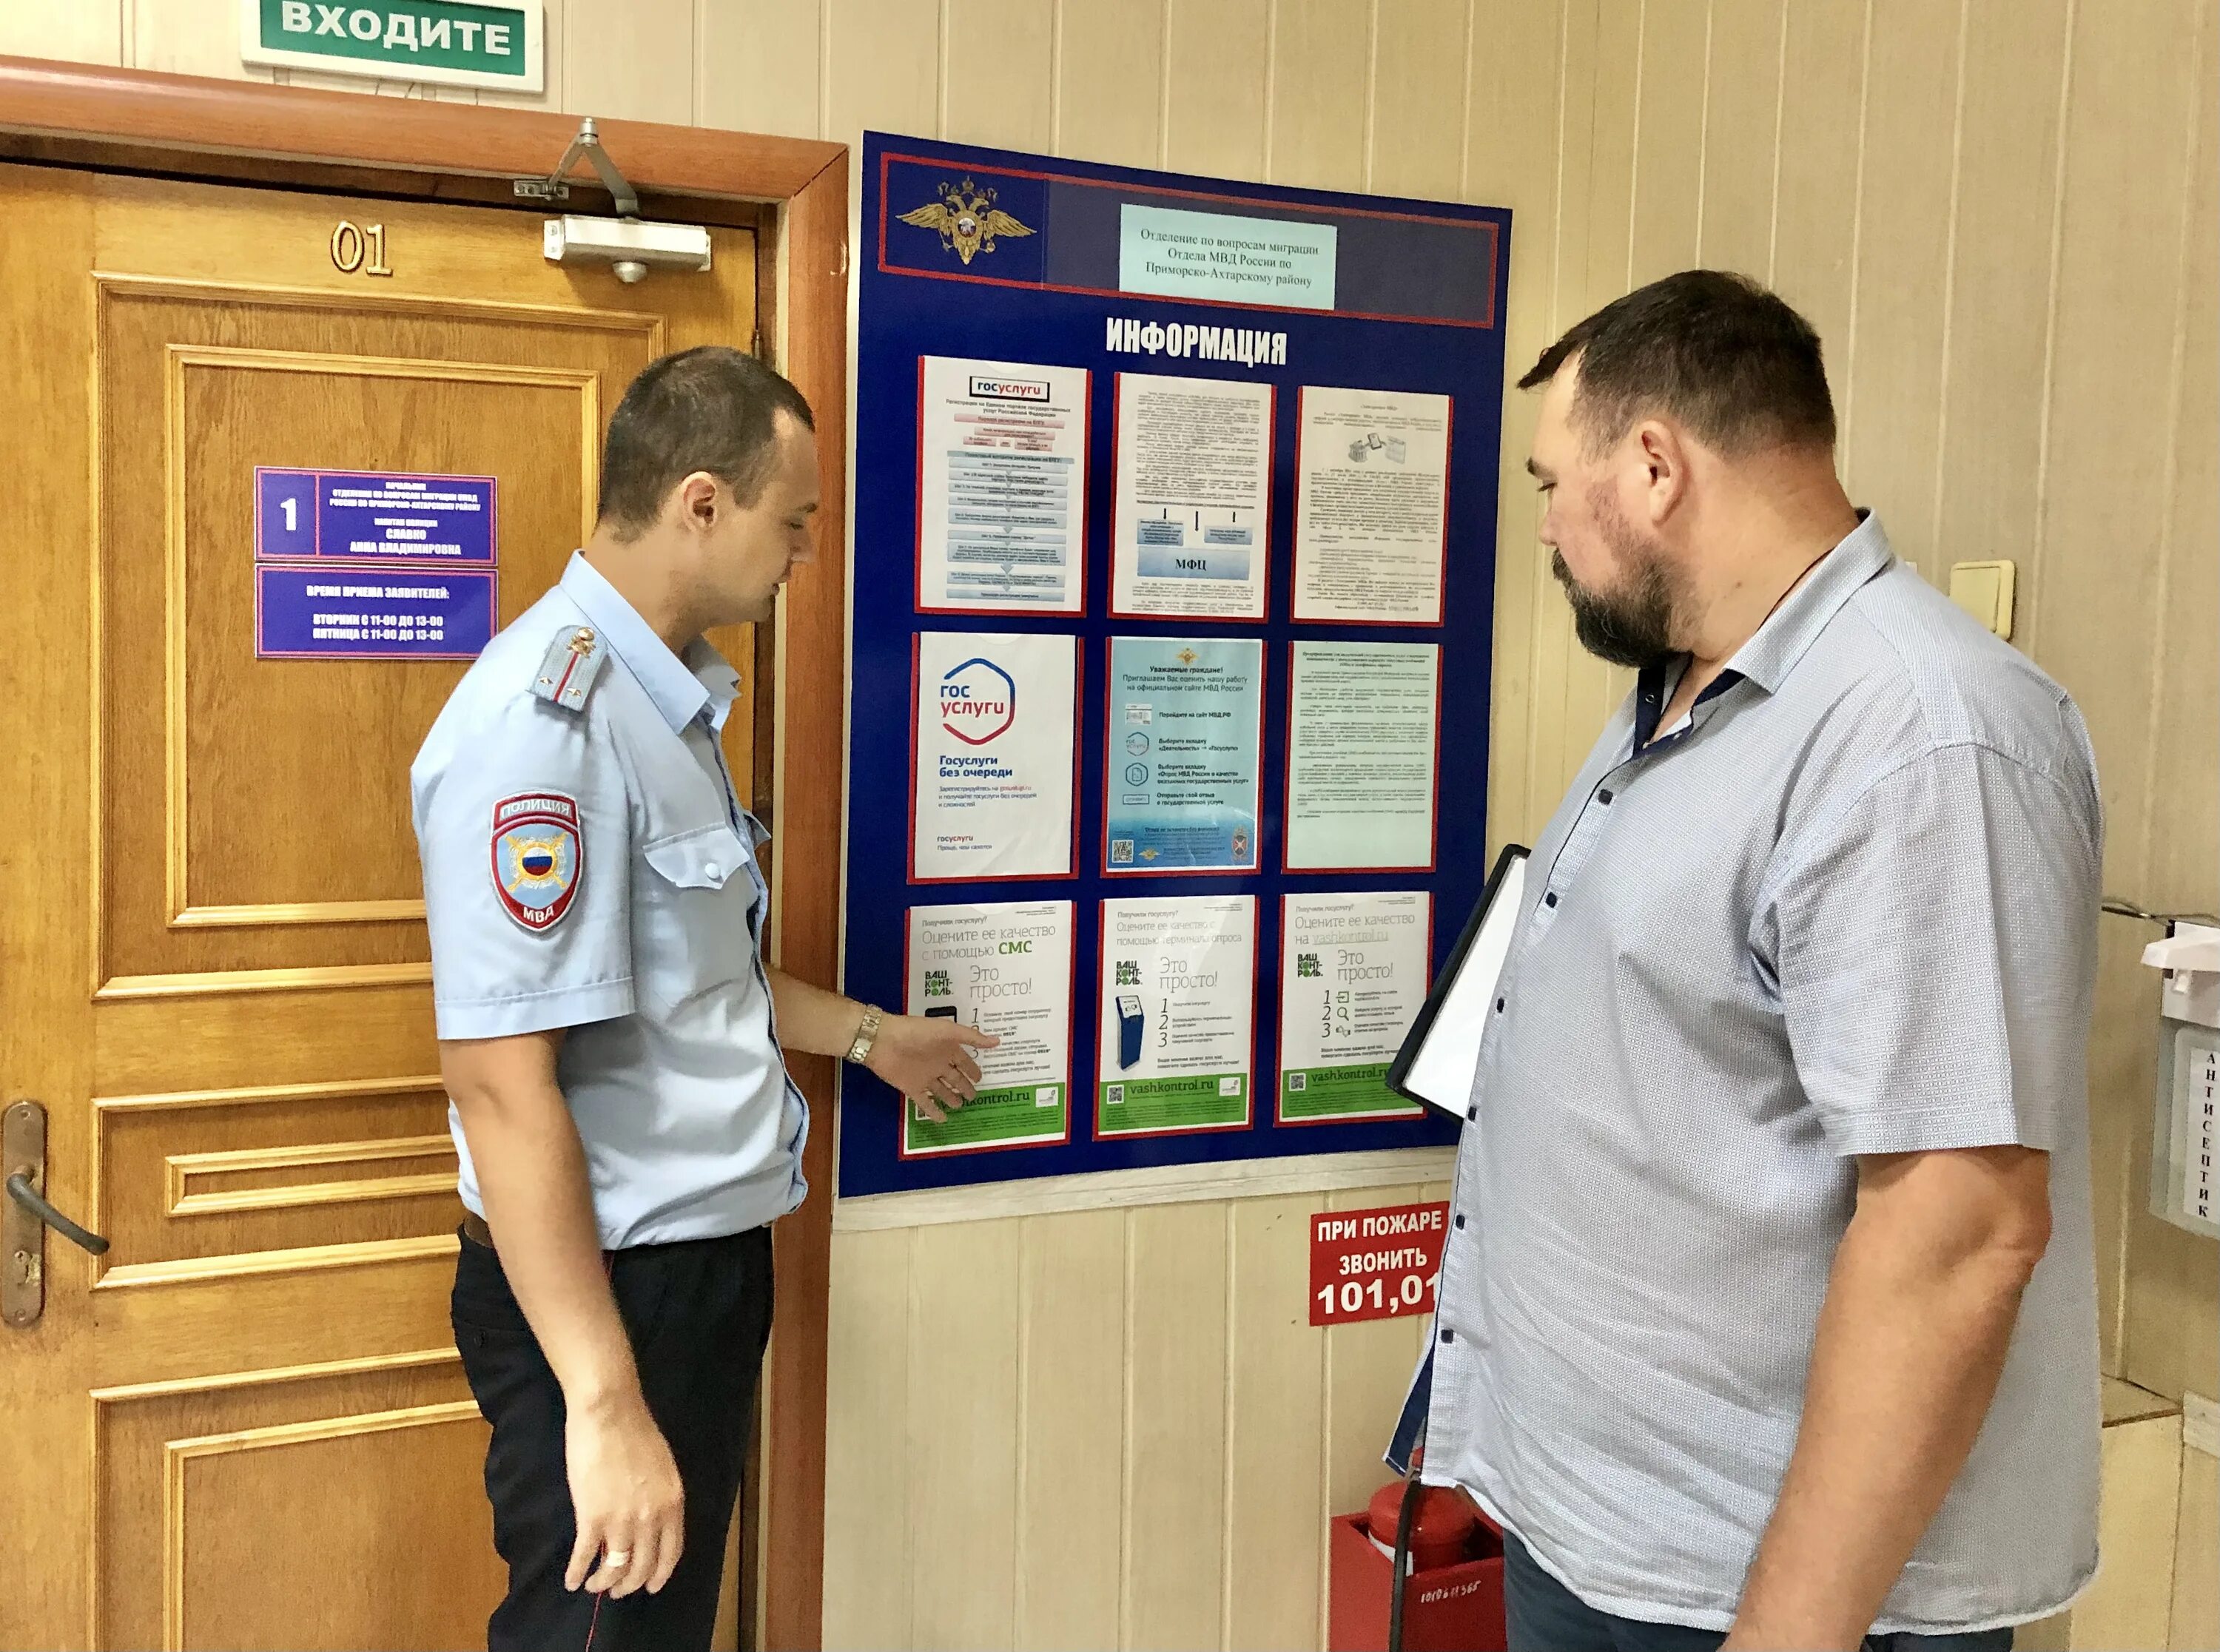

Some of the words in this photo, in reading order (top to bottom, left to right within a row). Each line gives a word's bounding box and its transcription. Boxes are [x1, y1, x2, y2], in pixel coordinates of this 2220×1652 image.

[282, 1, 511, 55] ВХОДИТЕ
[331, 221, 393, 277] 01
[1140, 229, 1198, 245] Отделение
[1201, 236, 1214, 248] по
[1217, 238, 1265, 252] вопросам
[1269, 242, 1319, 257] миграции
[1168, 248, 1206, 262] Отдела
[1209, 252, 1237, 266] МВД
[1240, 255, 1276, 269] России
[1279, 259, 1291, 270] по
[1146, 261, 1273, 286] Приморско-Ахтарскому
[1276, 274, 1312, 289] району
[1106, 317, 1287, 368] ИНФОРМАЦИЯ
[978, 381, 1040, 397] госуслуги
[280, 498, 296, 530] 1
[386, 528, 426, 540] СЛАВКО
[349, 541, 377, 553] АННА
[378, 542, 461, 555] ВЛАДИМИРОВНА
[1174, 559, 1207, 571] МФЦ
[306, 585, 341, 597] ВРЕМЯ
[343, 586, 383, 598] ПРИЕМА
[385, 587, 450, 599] ЗАЯВИТЕЛЕЙ:
[313, 614, 360, 625] ВТОРНИК
[361, 615, 369, 625] С
[371, 615, 397, 626] 11-00
[398, 616, 413, 627] ДО
[416, 616, 443, 627] 13-00
[313, 628, 360, 641] ПЯТНИЦА
[361, 629, 369, 639] С
[371, 629, 397, 640] 11-00
[398, 630, 414, 641] ДО
[416, 630, 443, 641] 13-00
[941, 685, 969, 698] гос
[941, 701, 1004, 718] услуги
[939, 755, 998, 767] Госуслуги
[939, 767, 960, 777] без
[963, 769, 1013, 778] очереди
[501, 798, 570, 818] ПОЛИЦИЯ
[523, 906, 554, 923] МВД
[1295, 916, 1345, 930] Оцените
[1348, 917, 1361, 926] ее
[1365, 914, 1415, 926] качество
[1117, 922, 1155, 932] Оцените
[1157, 922, 1168, 931] ее
[1170, 920, 1208, 929] качество
[922, 929, 978, 945] Оцените
[982, 929, 996, 940] ее
[1000, 925, 1056, 939] качество
[1117, 936, 1159, 945] помощью
[1212, 934, 1242, 944] опроса
[1294, 934, 1309, 945] на
[922, 951, 929, 961] с
[933, 945, 995, 960] помощью
[998, 940, 1032, 954] СМС
[1297, 953, 1317, 962] ВАШ
[1337, 949, 1365, 965] Это
[1116, 960, 1137, 969] ВАШ
[1160, 957, 1187, 974] Это
[925, 970, 947, 980] ВАШ
[970, 965, 999, 983] Это
[1337, 962, 1393, 984] просто!
[970, 977, 1032, 1002] просто!
[1160, 971, 1218, 993] просто!
[1323, 990, 1331, 1005] 1
[1160, 998, 1168, 1014] 1
[1322, 1005, 1331, 1021] 2
[971, 1008, 978, 1024] 1
[1158, 1014, 1168, 1030] 2
[1321, 1022, 1331, 1038] 3
[1157, 1032, 1168, 1048] 3
[1129, 1079, 1214, 1094] vashkontrol.ru
[2199, 1053, 2216, 1218] АНТИСЕПТИК
[1318, 1218, 1356, 1242] ПРИ
[1363, 1210, 1442, 1238] ПОЖАРЕ
[1339, 1247, 1427, 1275] ЗВОНИТЬ
[1318, 1272, 1439, 1314] 101,01
